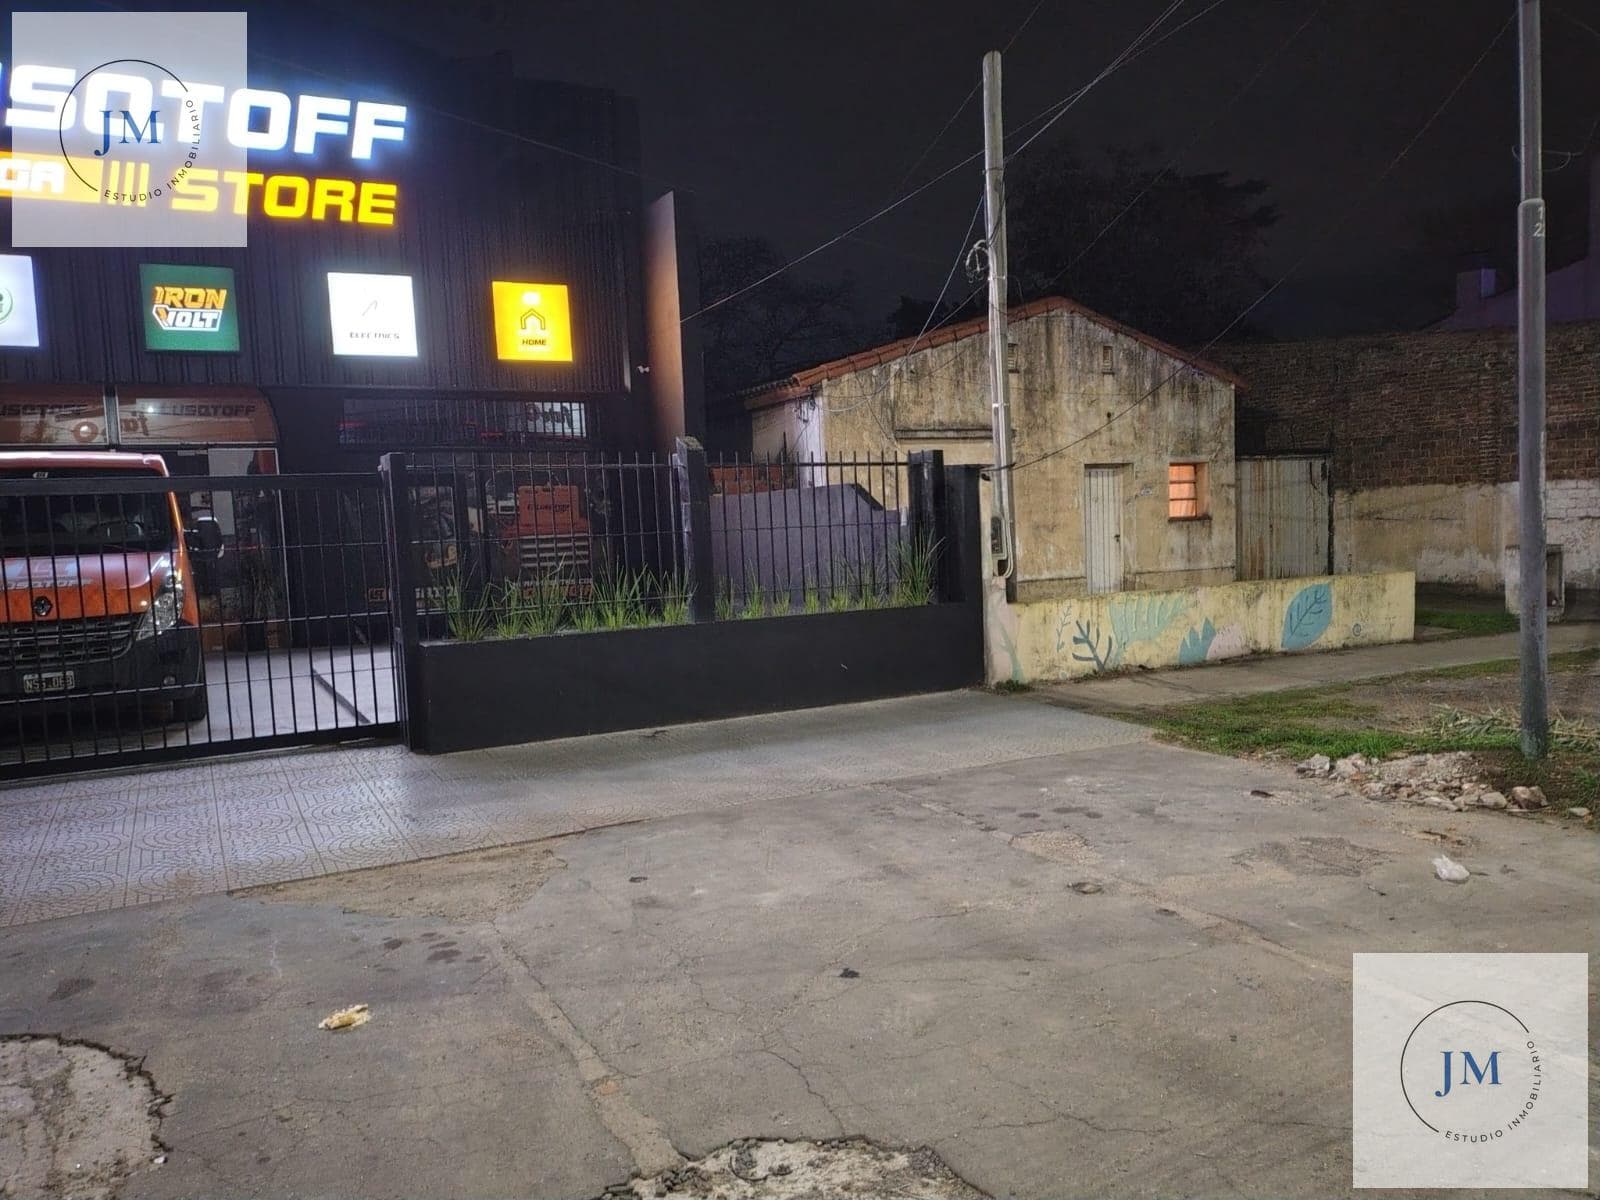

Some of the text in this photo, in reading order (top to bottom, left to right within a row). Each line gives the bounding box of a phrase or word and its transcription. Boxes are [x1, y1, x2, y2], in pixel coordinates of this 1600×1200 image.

[0, 62, 408, 160] SQTOFF
[171, 167, 397, 225] STORE
[153, 286, 227, 309] IRON
[156, 308, 218, 328] VOLT
[522, 338, 547, 346] HOME
